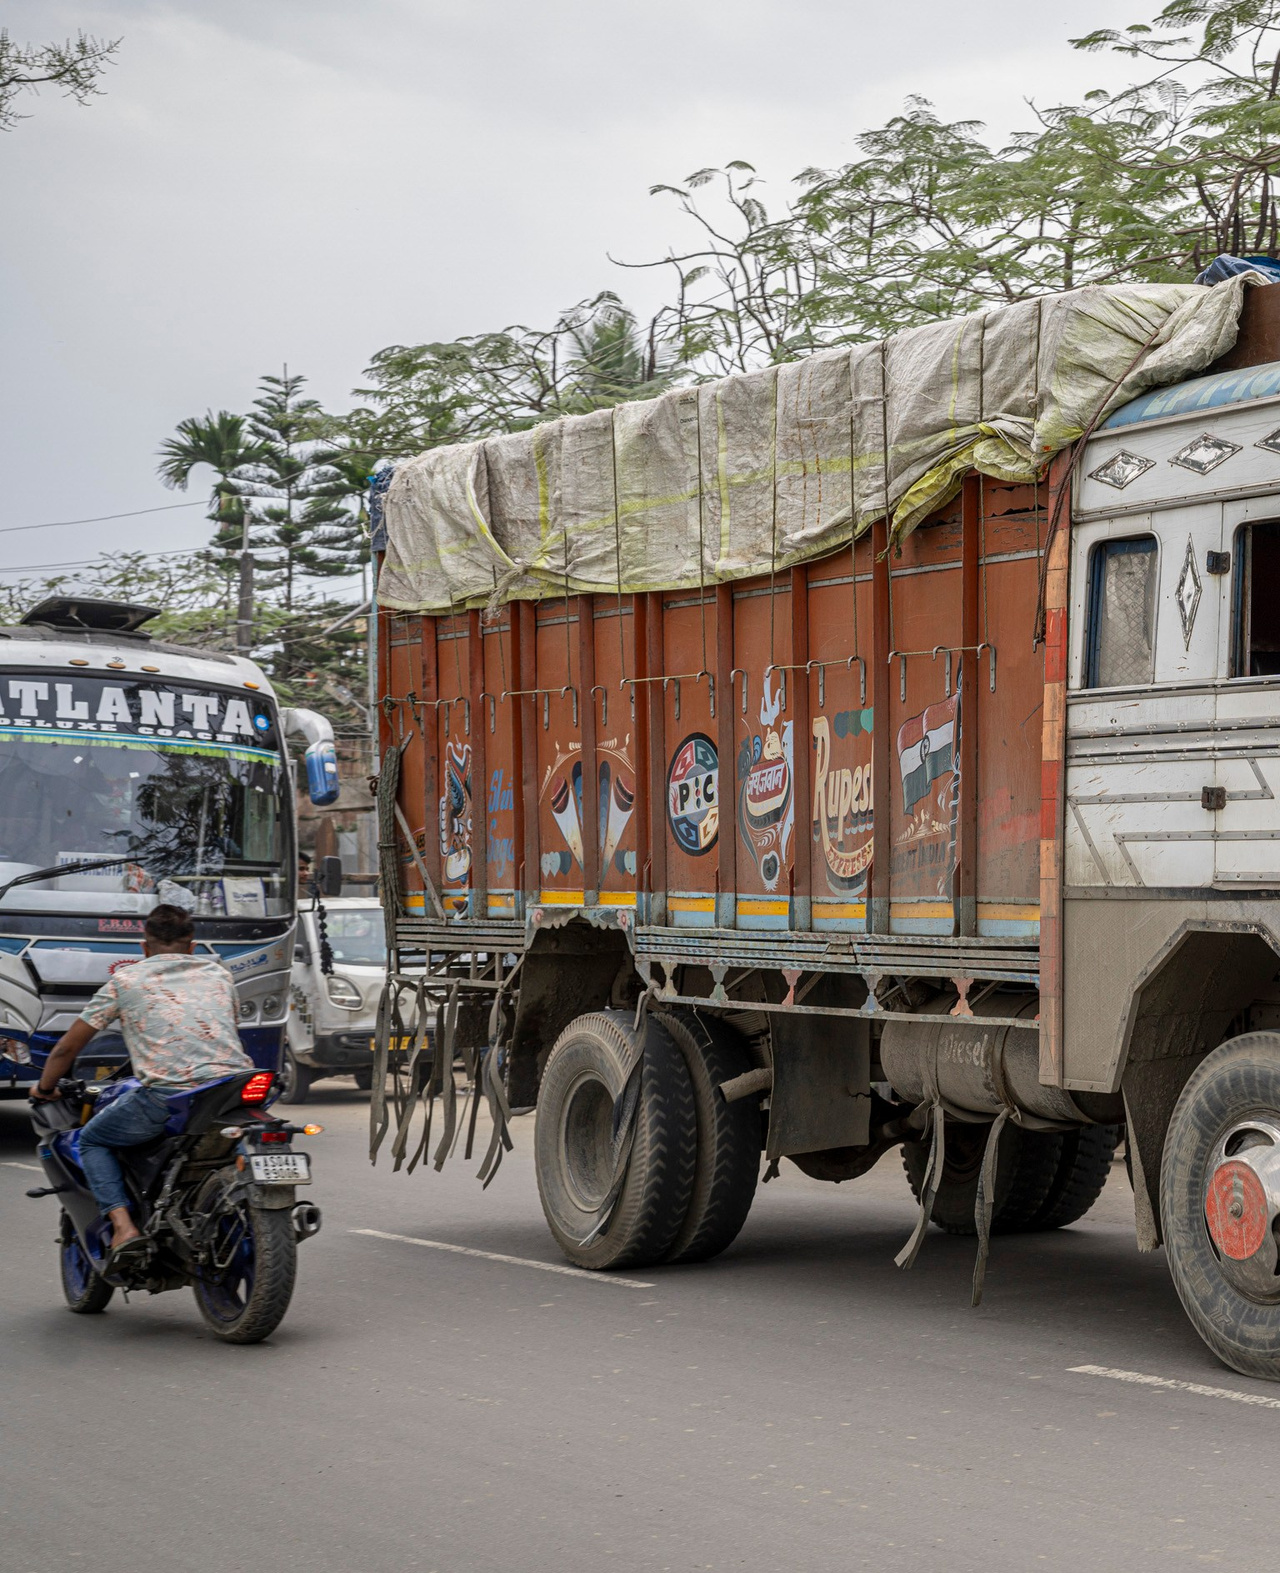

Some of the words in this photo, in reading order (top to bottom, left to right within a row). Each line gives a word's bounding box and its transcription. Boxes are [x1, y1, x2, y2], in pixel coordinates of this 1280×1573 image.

[138, 726, 233, 742] COACH
[827, 846, 868, 876] EXPRESS
[939, 1033, 989, 1068] Diesel
